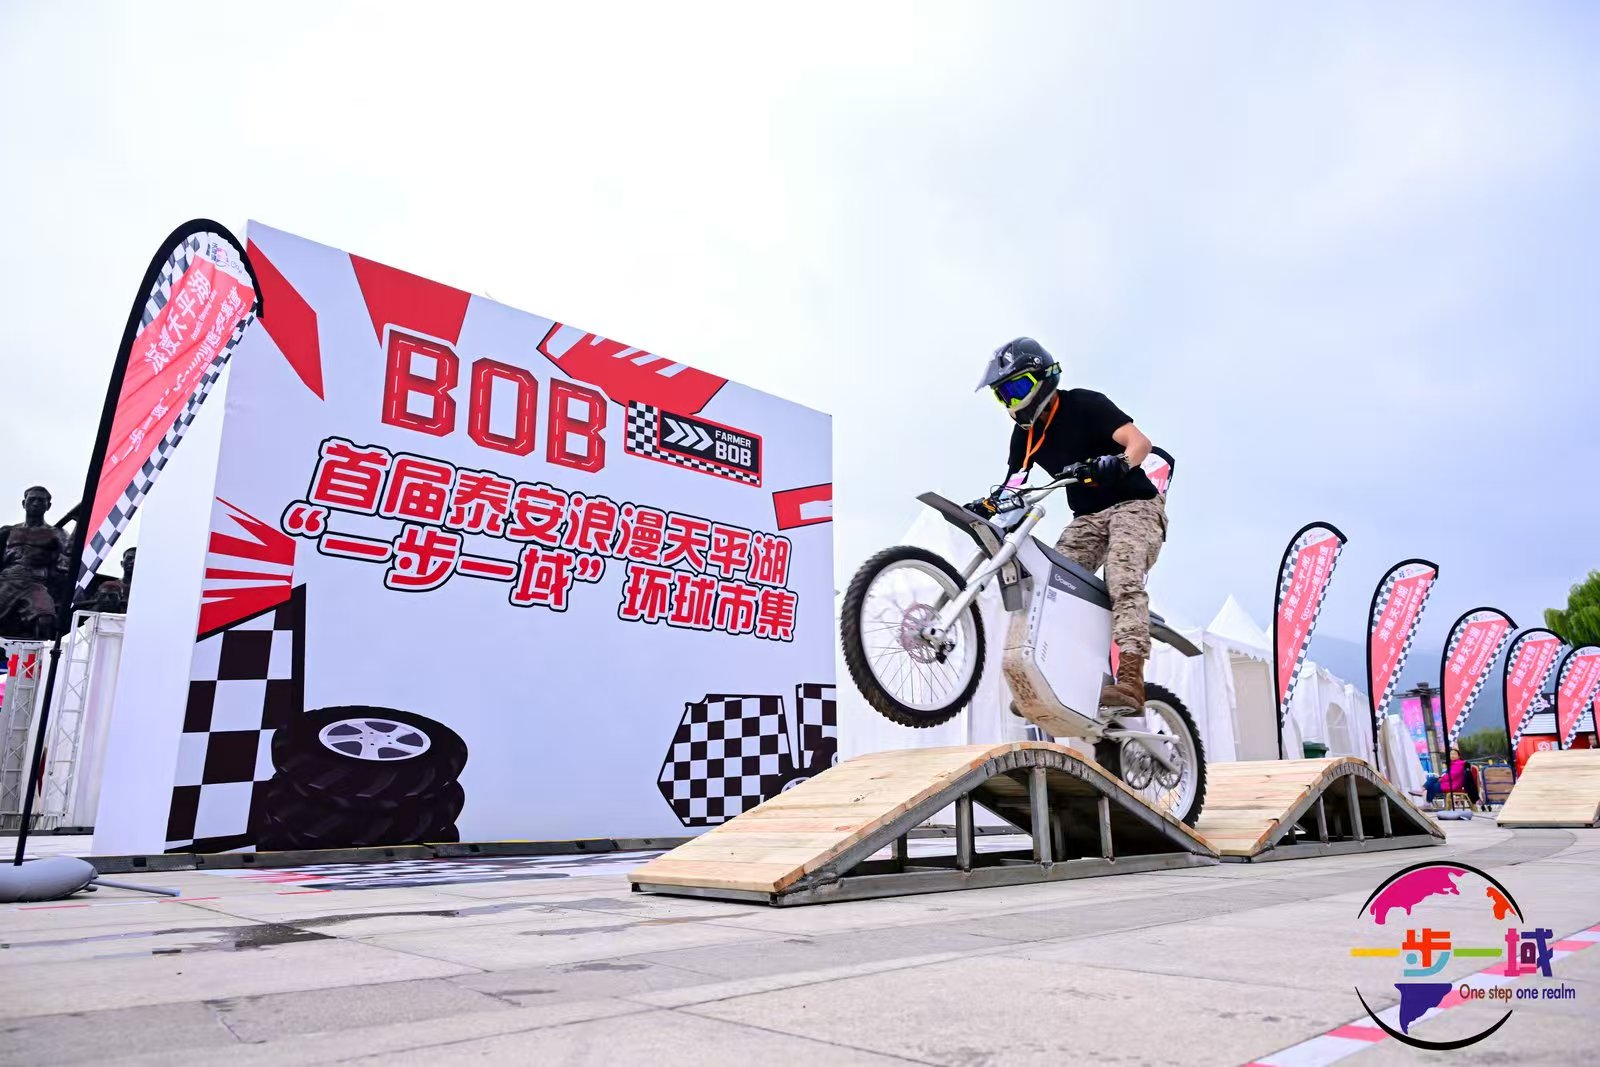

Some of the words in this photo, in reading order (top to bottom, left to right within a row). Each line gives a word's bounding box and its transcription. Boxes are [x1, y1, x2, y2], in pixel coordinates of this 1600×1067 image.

[381, 326, 608, 473] BOB
[715, 429, 752, 449] FARMER
[715, 440, 752, 467] BOB
[310, 439, 792, 588] 首届泰安浪漫天平湖
[619, 562, 798, 641] 环球市集
